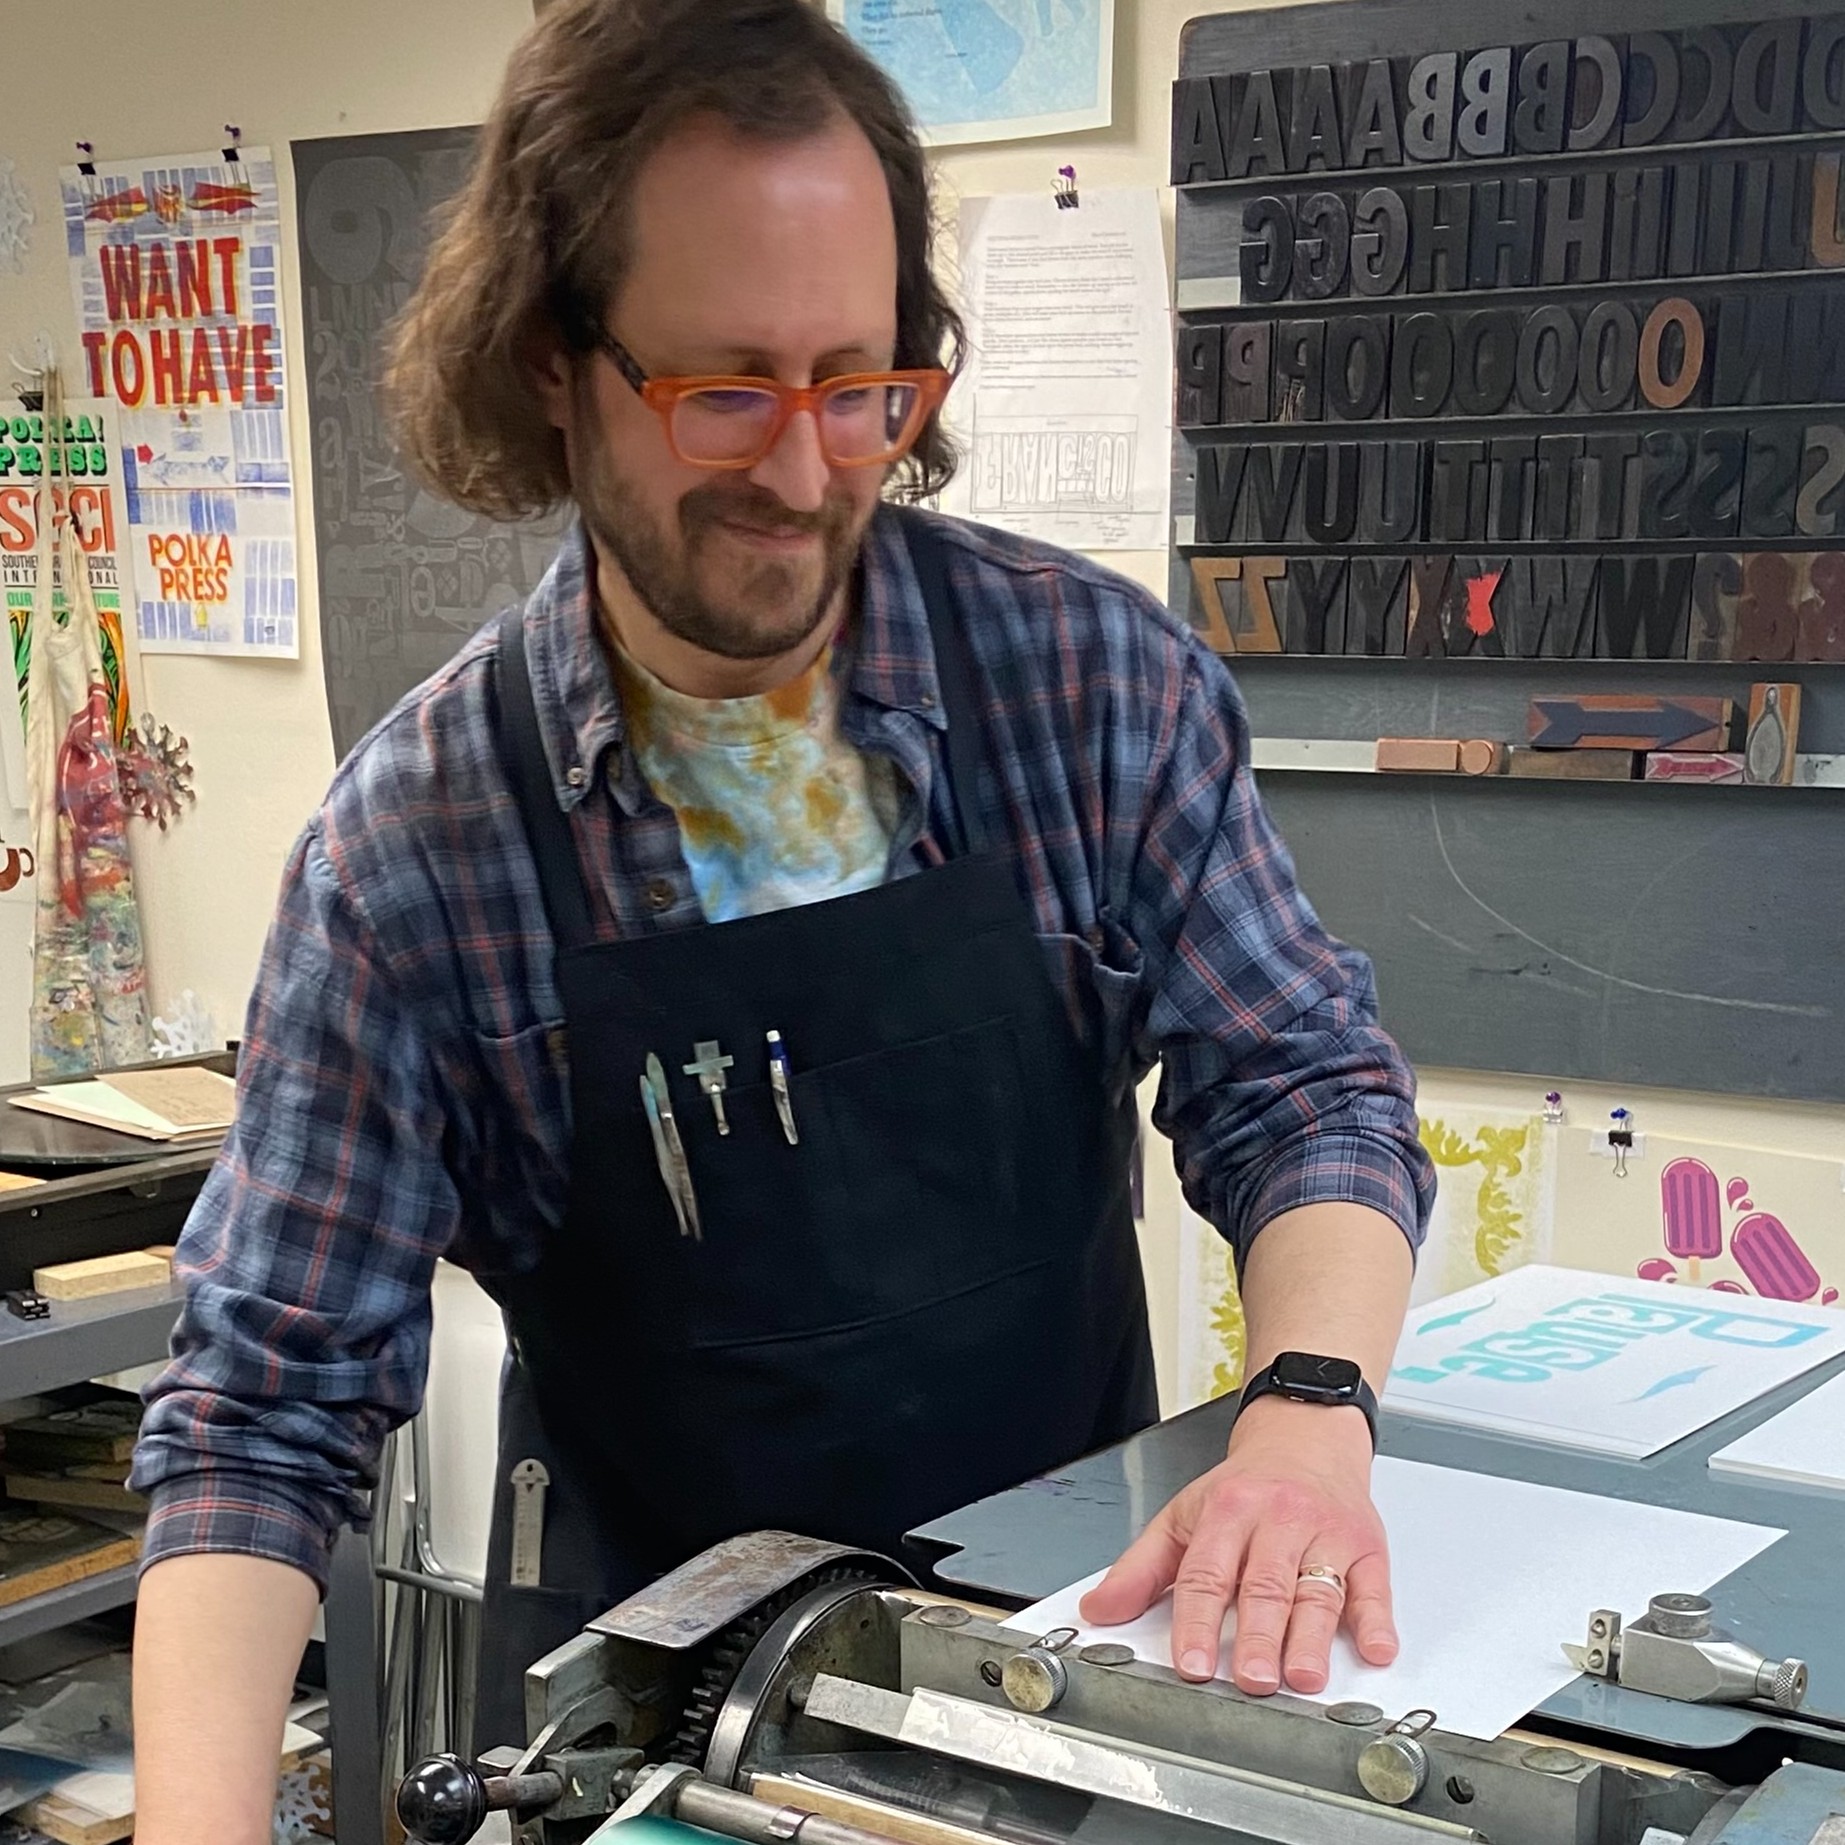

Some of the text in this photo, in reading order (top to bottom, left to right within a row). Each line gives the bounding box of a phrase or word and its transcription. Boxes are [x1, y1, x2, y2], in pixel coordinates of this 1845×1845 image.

[99, 237, 240, 321] WANT
[147, 533, 233, 567] POLKA
[159, 567, 228, 602] PRESS
